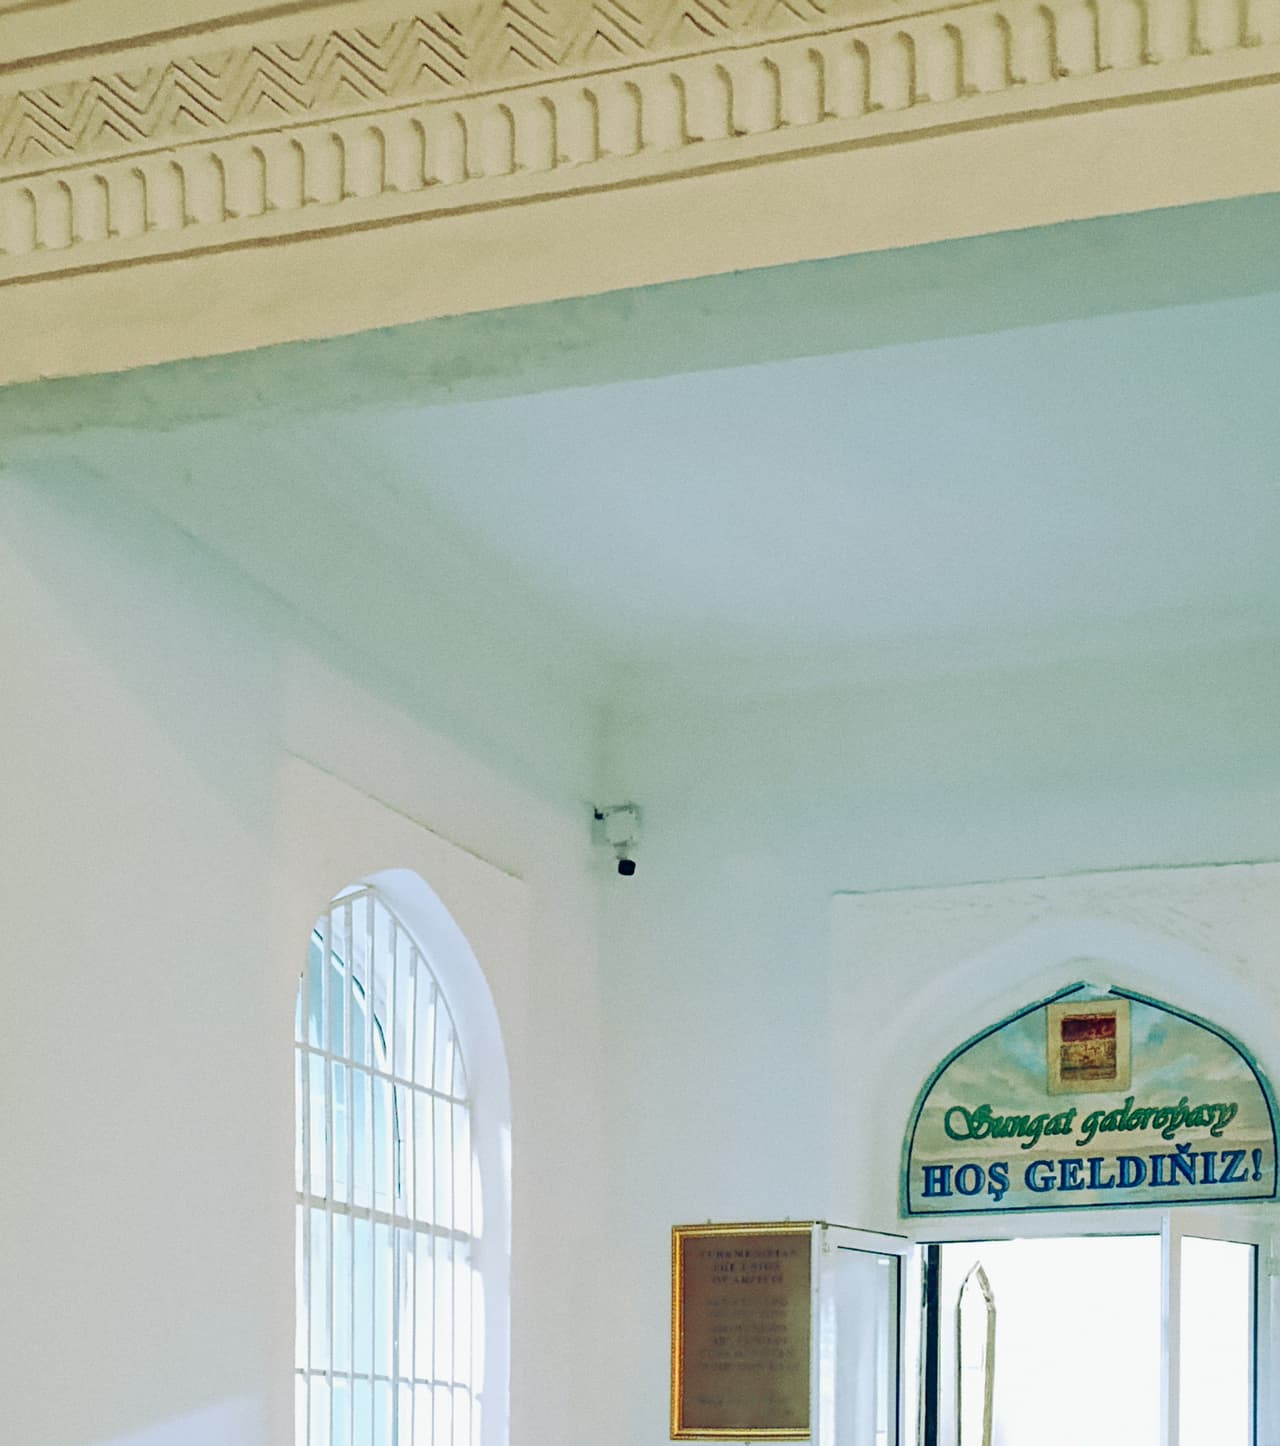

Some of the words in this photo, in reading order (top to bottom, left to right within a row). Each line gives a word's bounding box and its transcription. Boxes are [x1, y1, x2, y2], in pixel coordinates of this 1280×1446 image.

[944, 1102, 1077, 1149] Sungat
[921, 1161, 1010, 1202] HOŞ
[1024, 1142, 1263, 1193] GELDIŇIZ!
